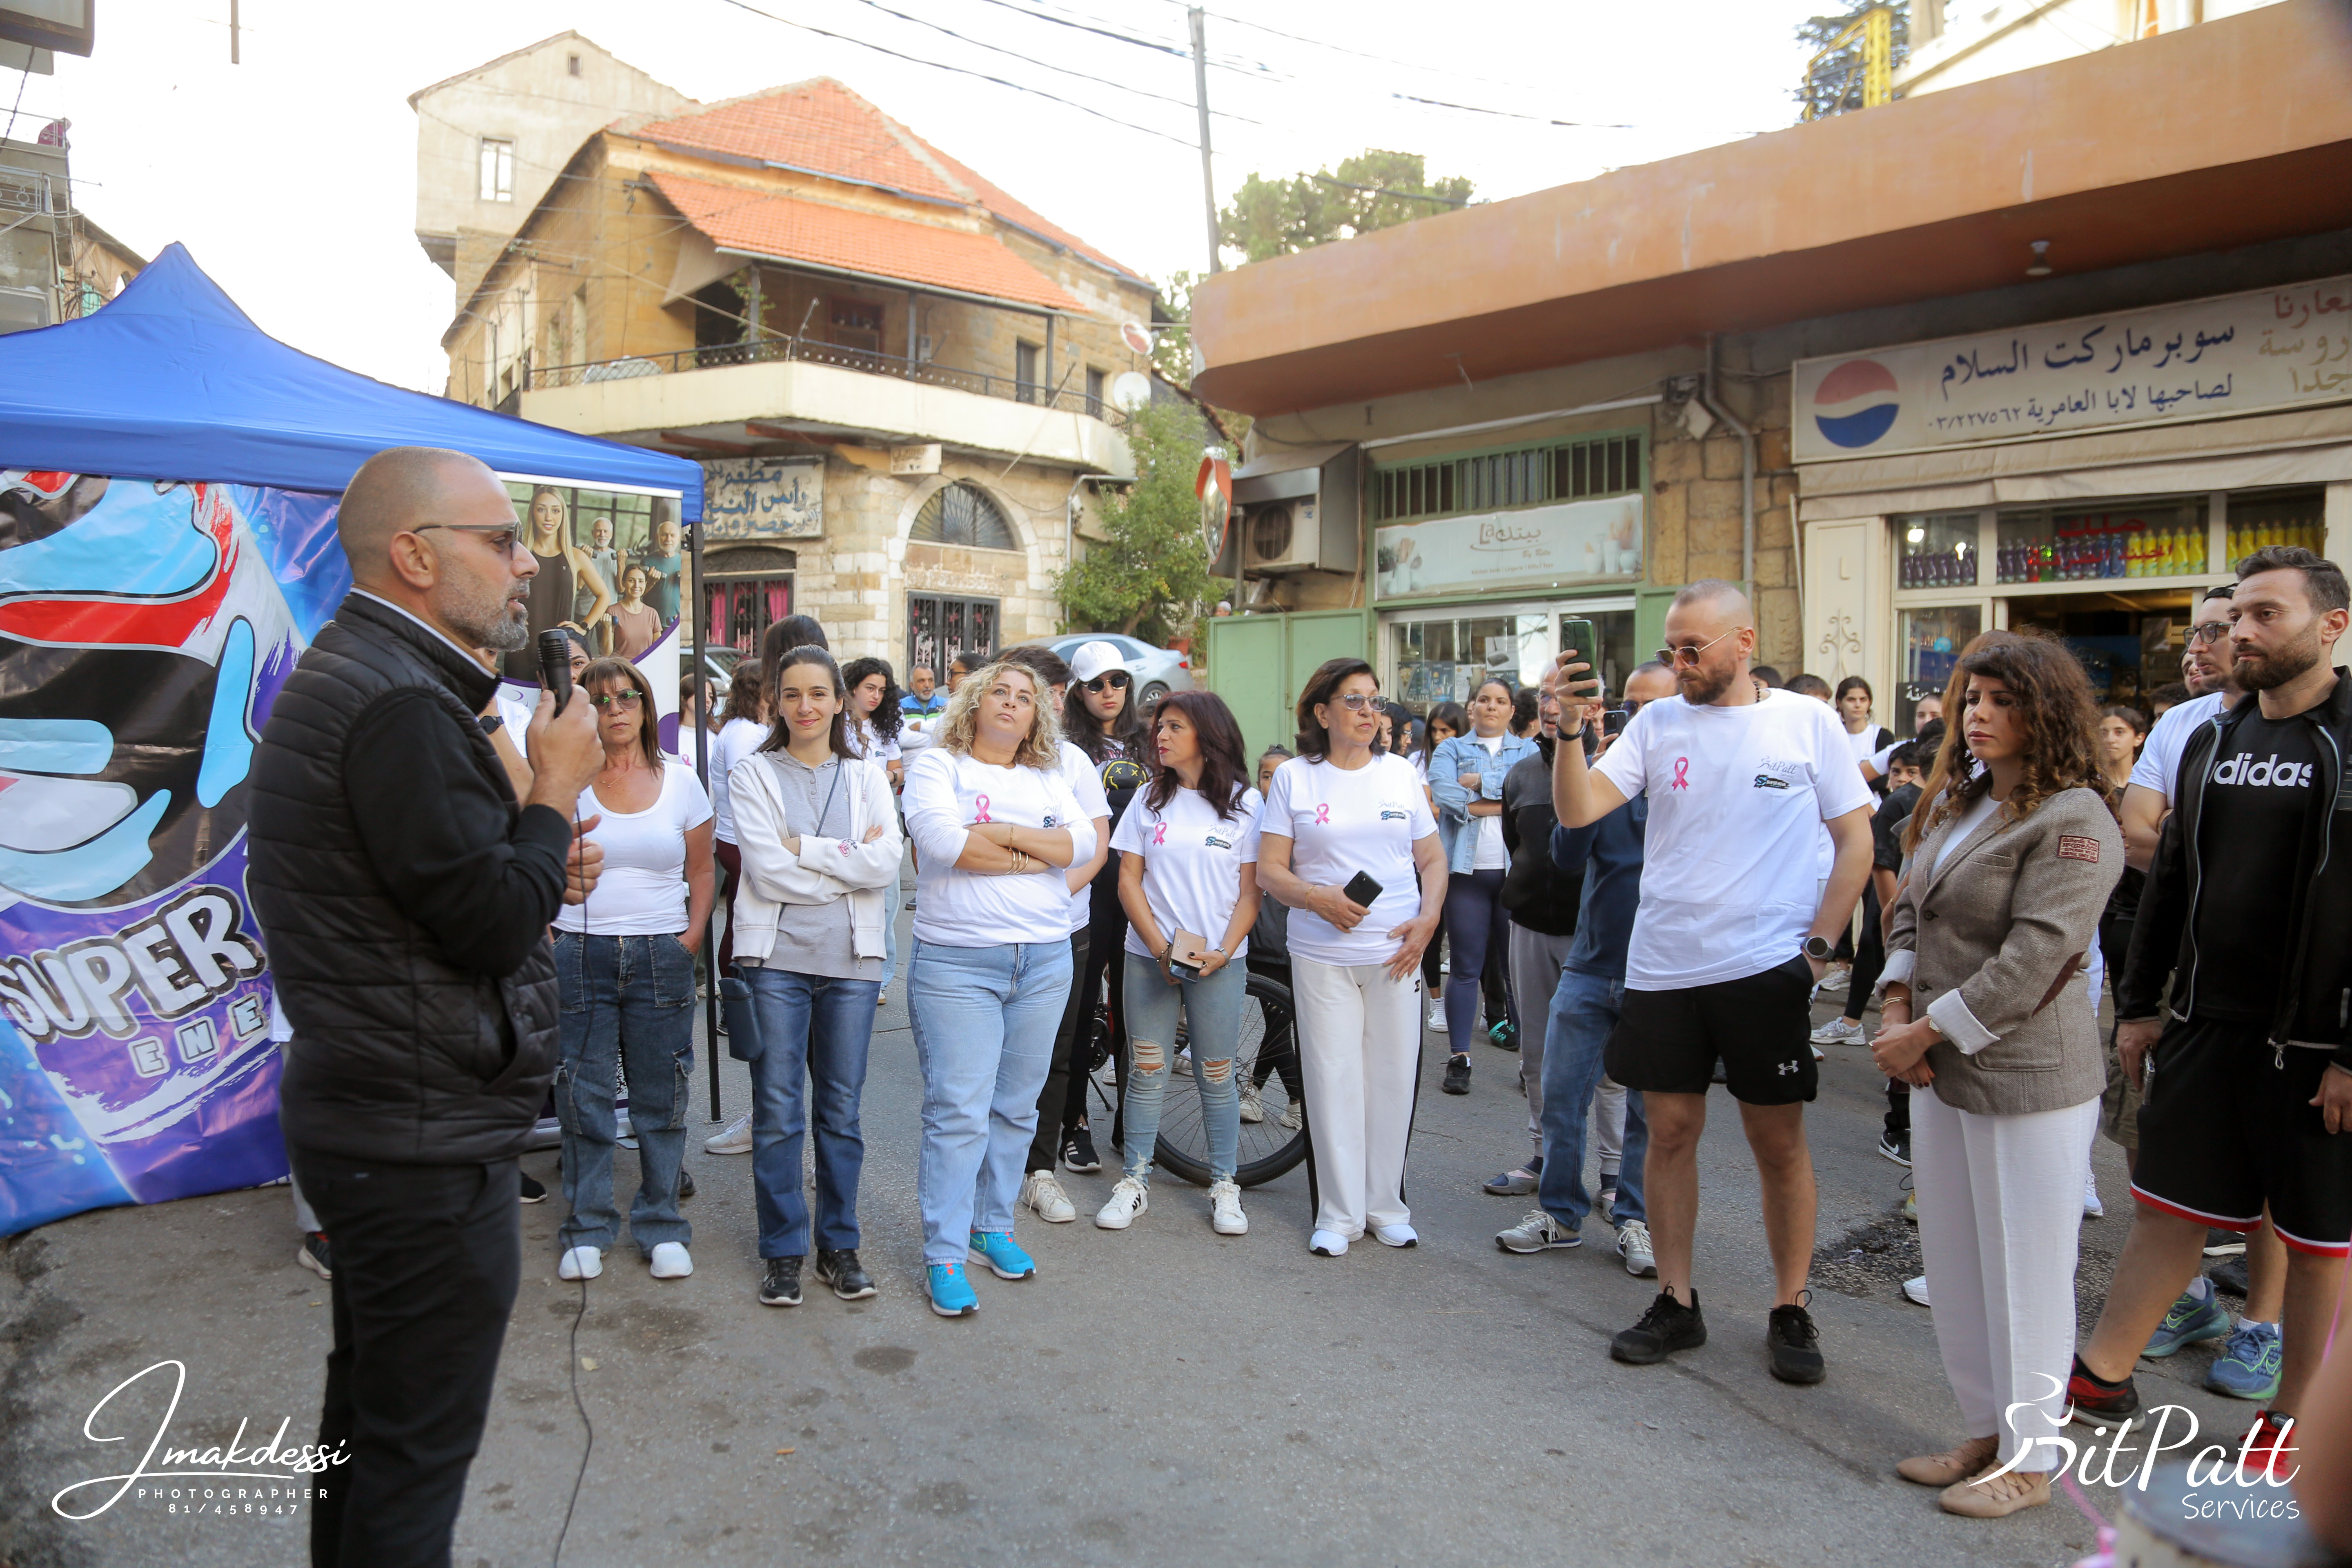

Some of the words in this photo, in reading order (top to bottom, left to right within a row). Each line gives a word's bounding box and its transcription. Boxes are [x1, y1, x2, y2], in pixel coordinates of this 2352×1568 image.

[2258, 329, 2350, 366] روسة
[1942, 339, 2028, 402] السلام
[2148, 372, 2233, 412] لصاحبها
[721, 457, 783, 490] مطعم
[2207, 753, 2313, 787] didas
[0, 894, 257, 1036] SUPER
[133, 996, 263, 1070] ENE
